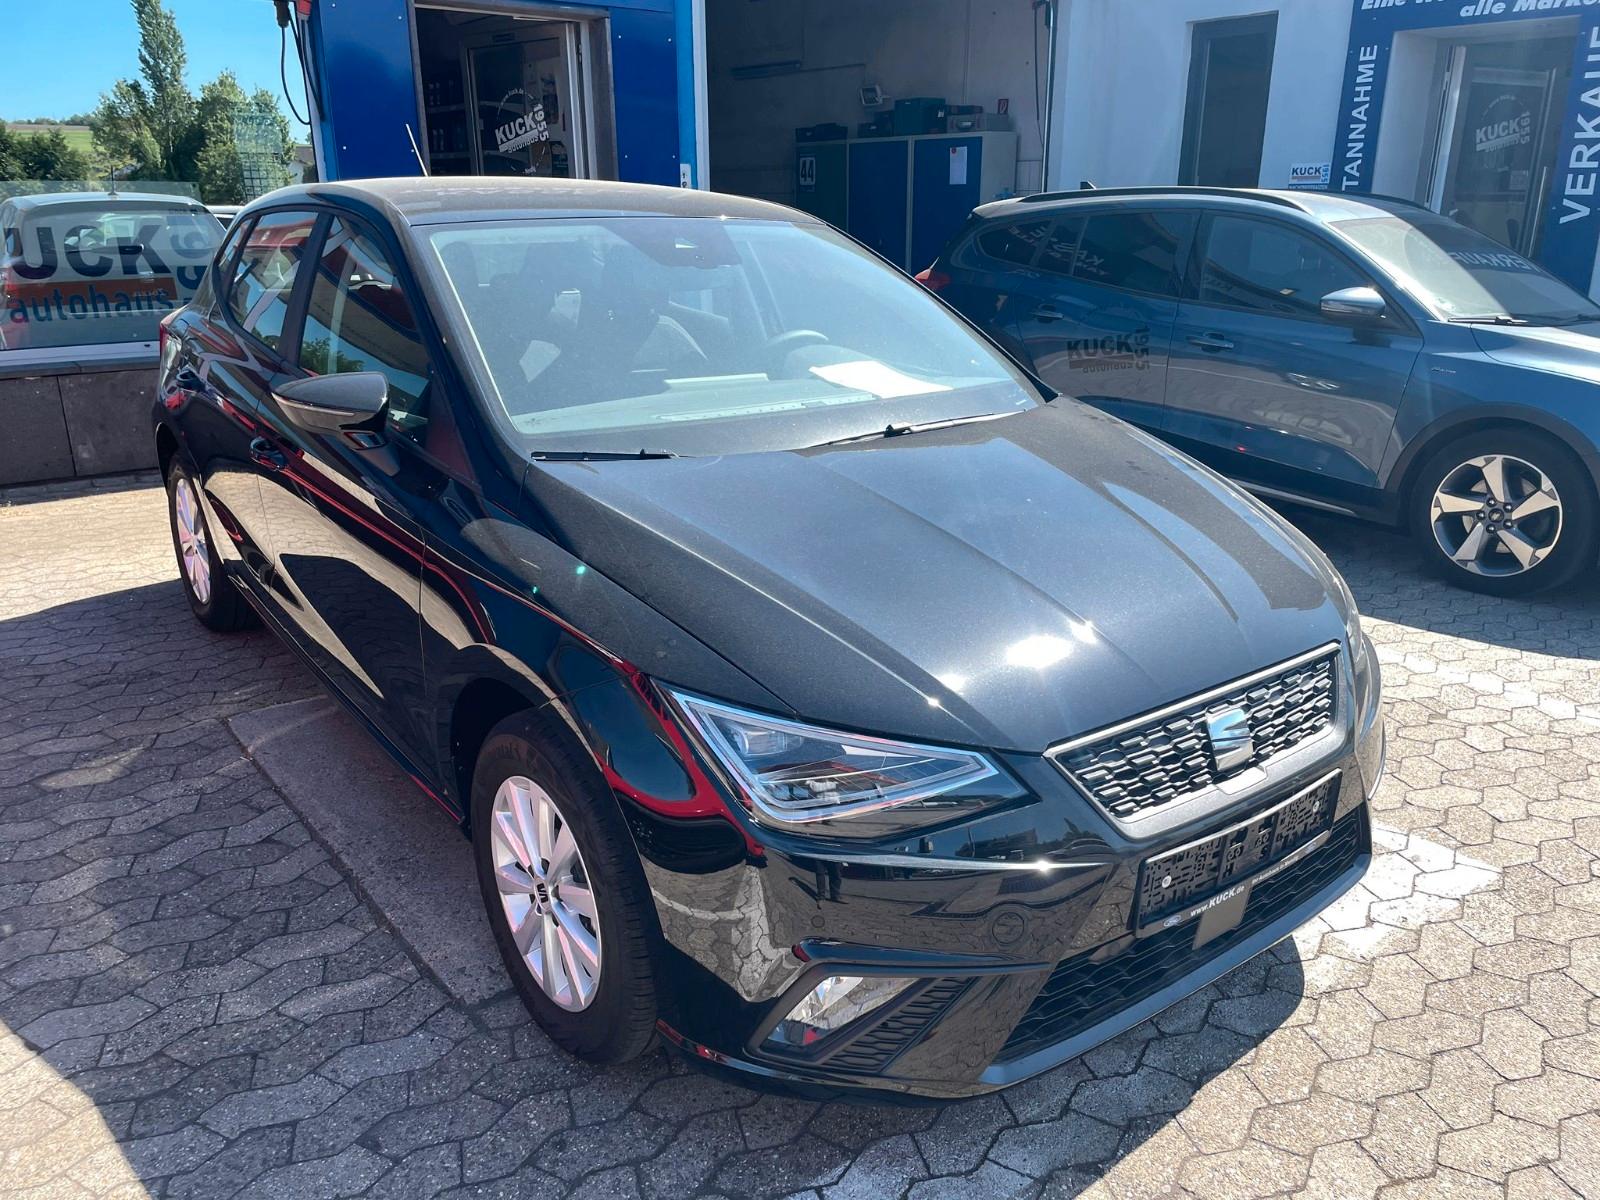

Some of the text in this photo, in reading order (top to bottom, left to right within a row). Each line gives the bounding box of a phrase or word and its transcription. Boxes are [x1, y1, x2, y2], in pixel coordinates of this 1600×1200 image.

[1460, 0, 1506, 17] alle
[495, 112, 537, 145] KUCK
[533, 103, 550, 142] 1955
[1341, 45, 1378, 191] TANNAHME
[1475, 117, 1520, 144] KUCK
[800, 159, 814, 183] 44
[1291, 166, 1322, 176] KUCK
[10, 284, 174, 323] autohaus
[1067, 333, 1133, 360] KUCK
[1190, 885, 1245, 917] www.KUCK.de
